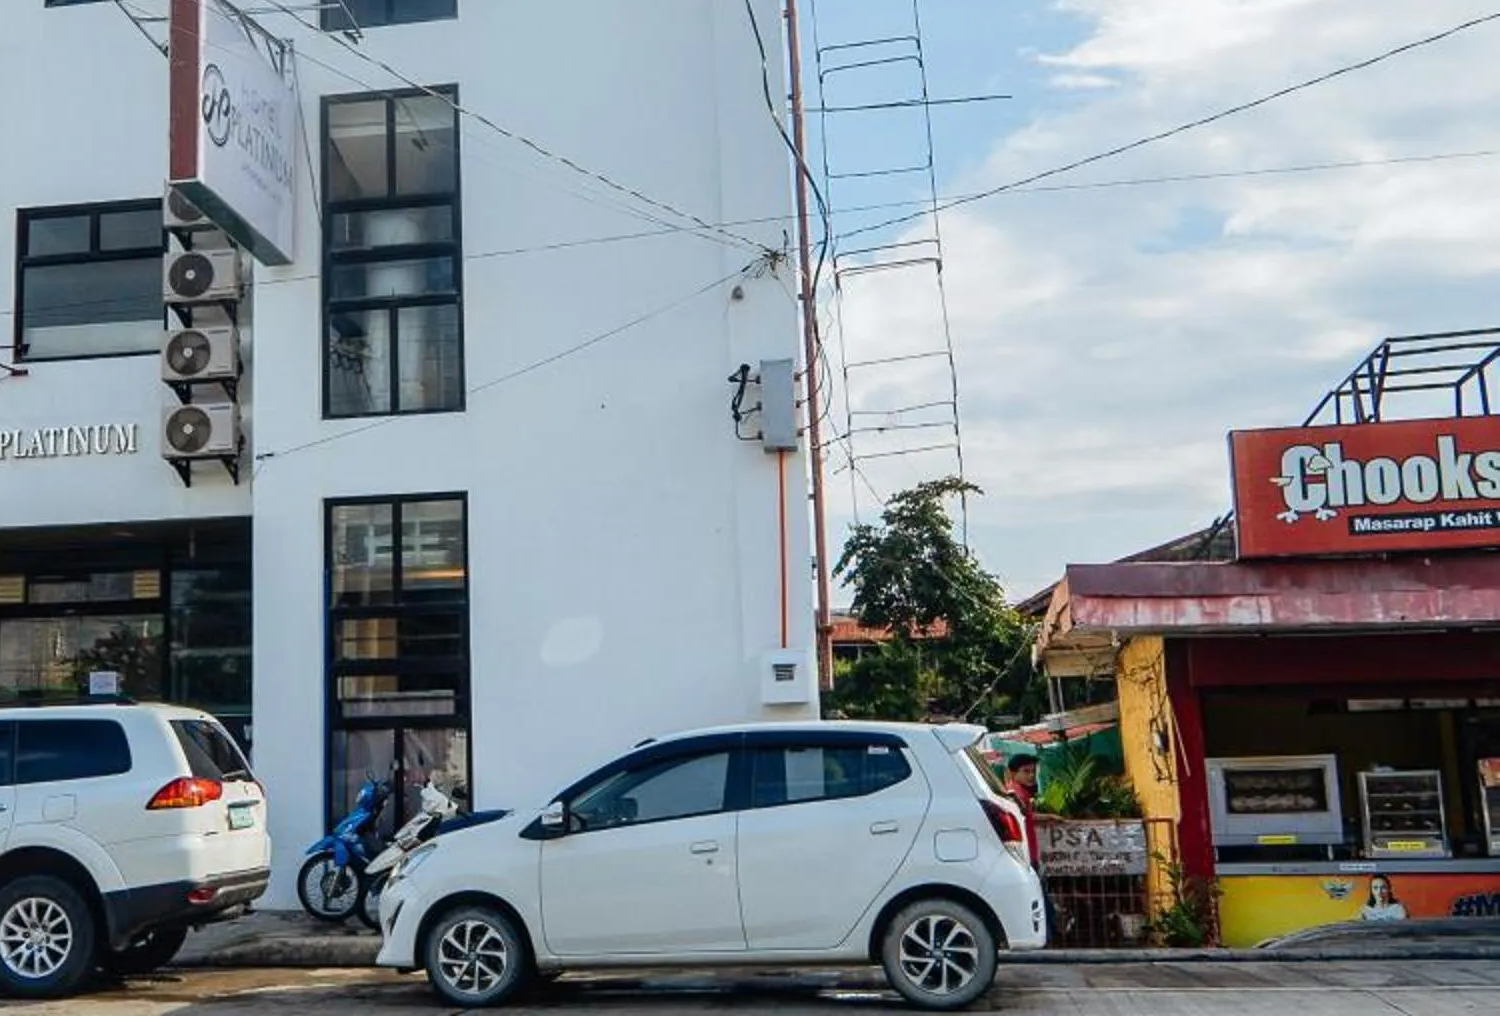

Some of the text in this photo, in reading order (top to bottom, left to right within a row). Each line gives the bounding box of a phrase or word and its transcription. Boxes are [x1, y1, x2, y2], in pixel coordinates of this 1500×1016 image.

[1281, 434, 1500, 513] Chooks
[1354, 517, 1436, 532] Masarap
[1440, 512, 1493, 527] Kahit
[1050, 827, 1104, 847] PSA
